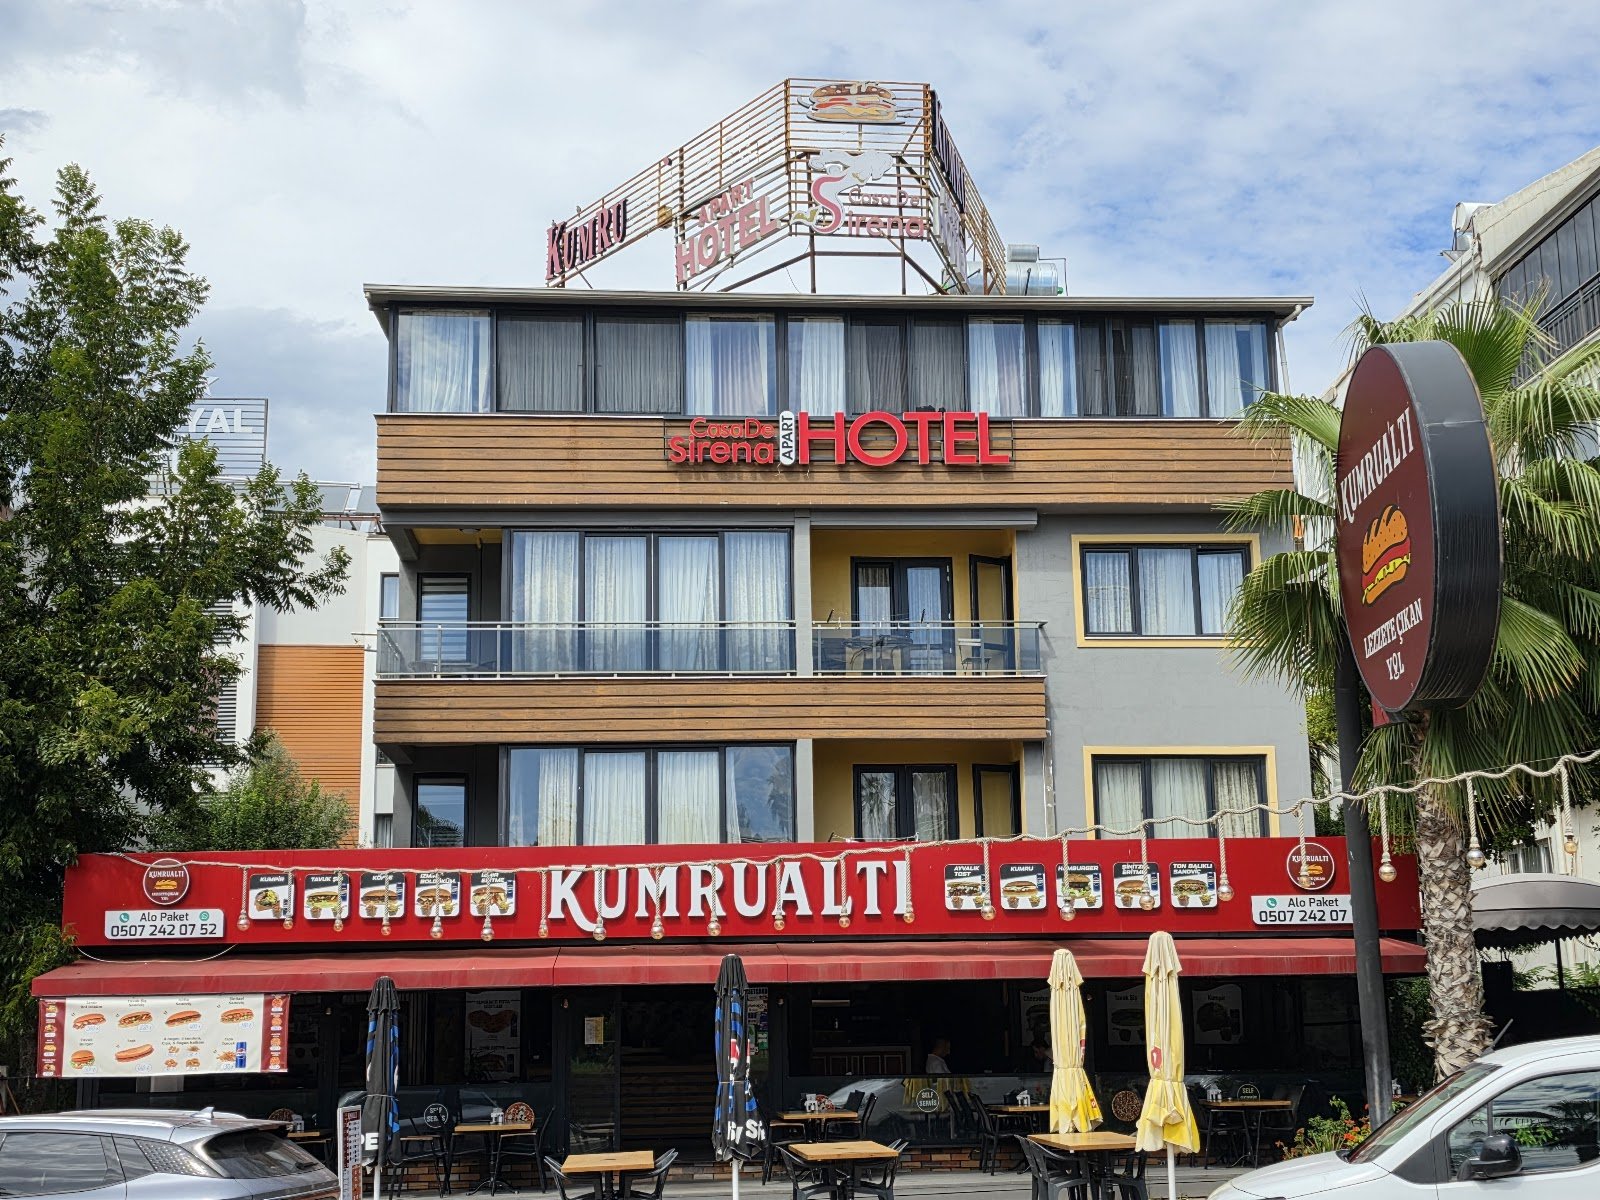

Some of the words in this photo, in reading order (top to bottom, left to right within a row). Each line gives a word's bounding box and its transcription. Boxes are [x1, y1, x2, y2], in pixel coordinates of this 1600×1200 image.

[698, 177, 757, 228] APART
[810, 174, 926, 239] Sirena
[848, 187, 891, 206] Casa
[896, 188, 920, 207] De
[545, 198, 628, 281] KUMRU
[675, 195, 781, 285] HOTEL
[667, 435, 774, 465] Sirena
[781, 415, 794, 461] APART
[797, 410, 1011, 467] HOTEL
[1363, 616, 1397, 659] LEZZETE
[1395, 597, 1423, 646] ÇIKAN
[1291, 855, 1329, 863] KURUALTI
[148, 870, 185, 879] KUMRUALTI
[548, 859, 910, 933] KUMRUALTI
[1287, 897, 1306, 908] Alo
[1308, 896, 1339, 907] Paket
[139, 912, 158, 922] Alo
[160, 911, 190, 922] Paket
[1258, 910, 1295, 923] 0507
[1298, 909, 1327, 922] 242
[1329, 909, 1348, 922] 07
[110, 924, 145, 937] 0507
[148, 924, 176, 937] 242
[178, 923, 197, 936] 07
[199, 923, 218, 935] 52
[921, 1091, 934, 1099] SELF
